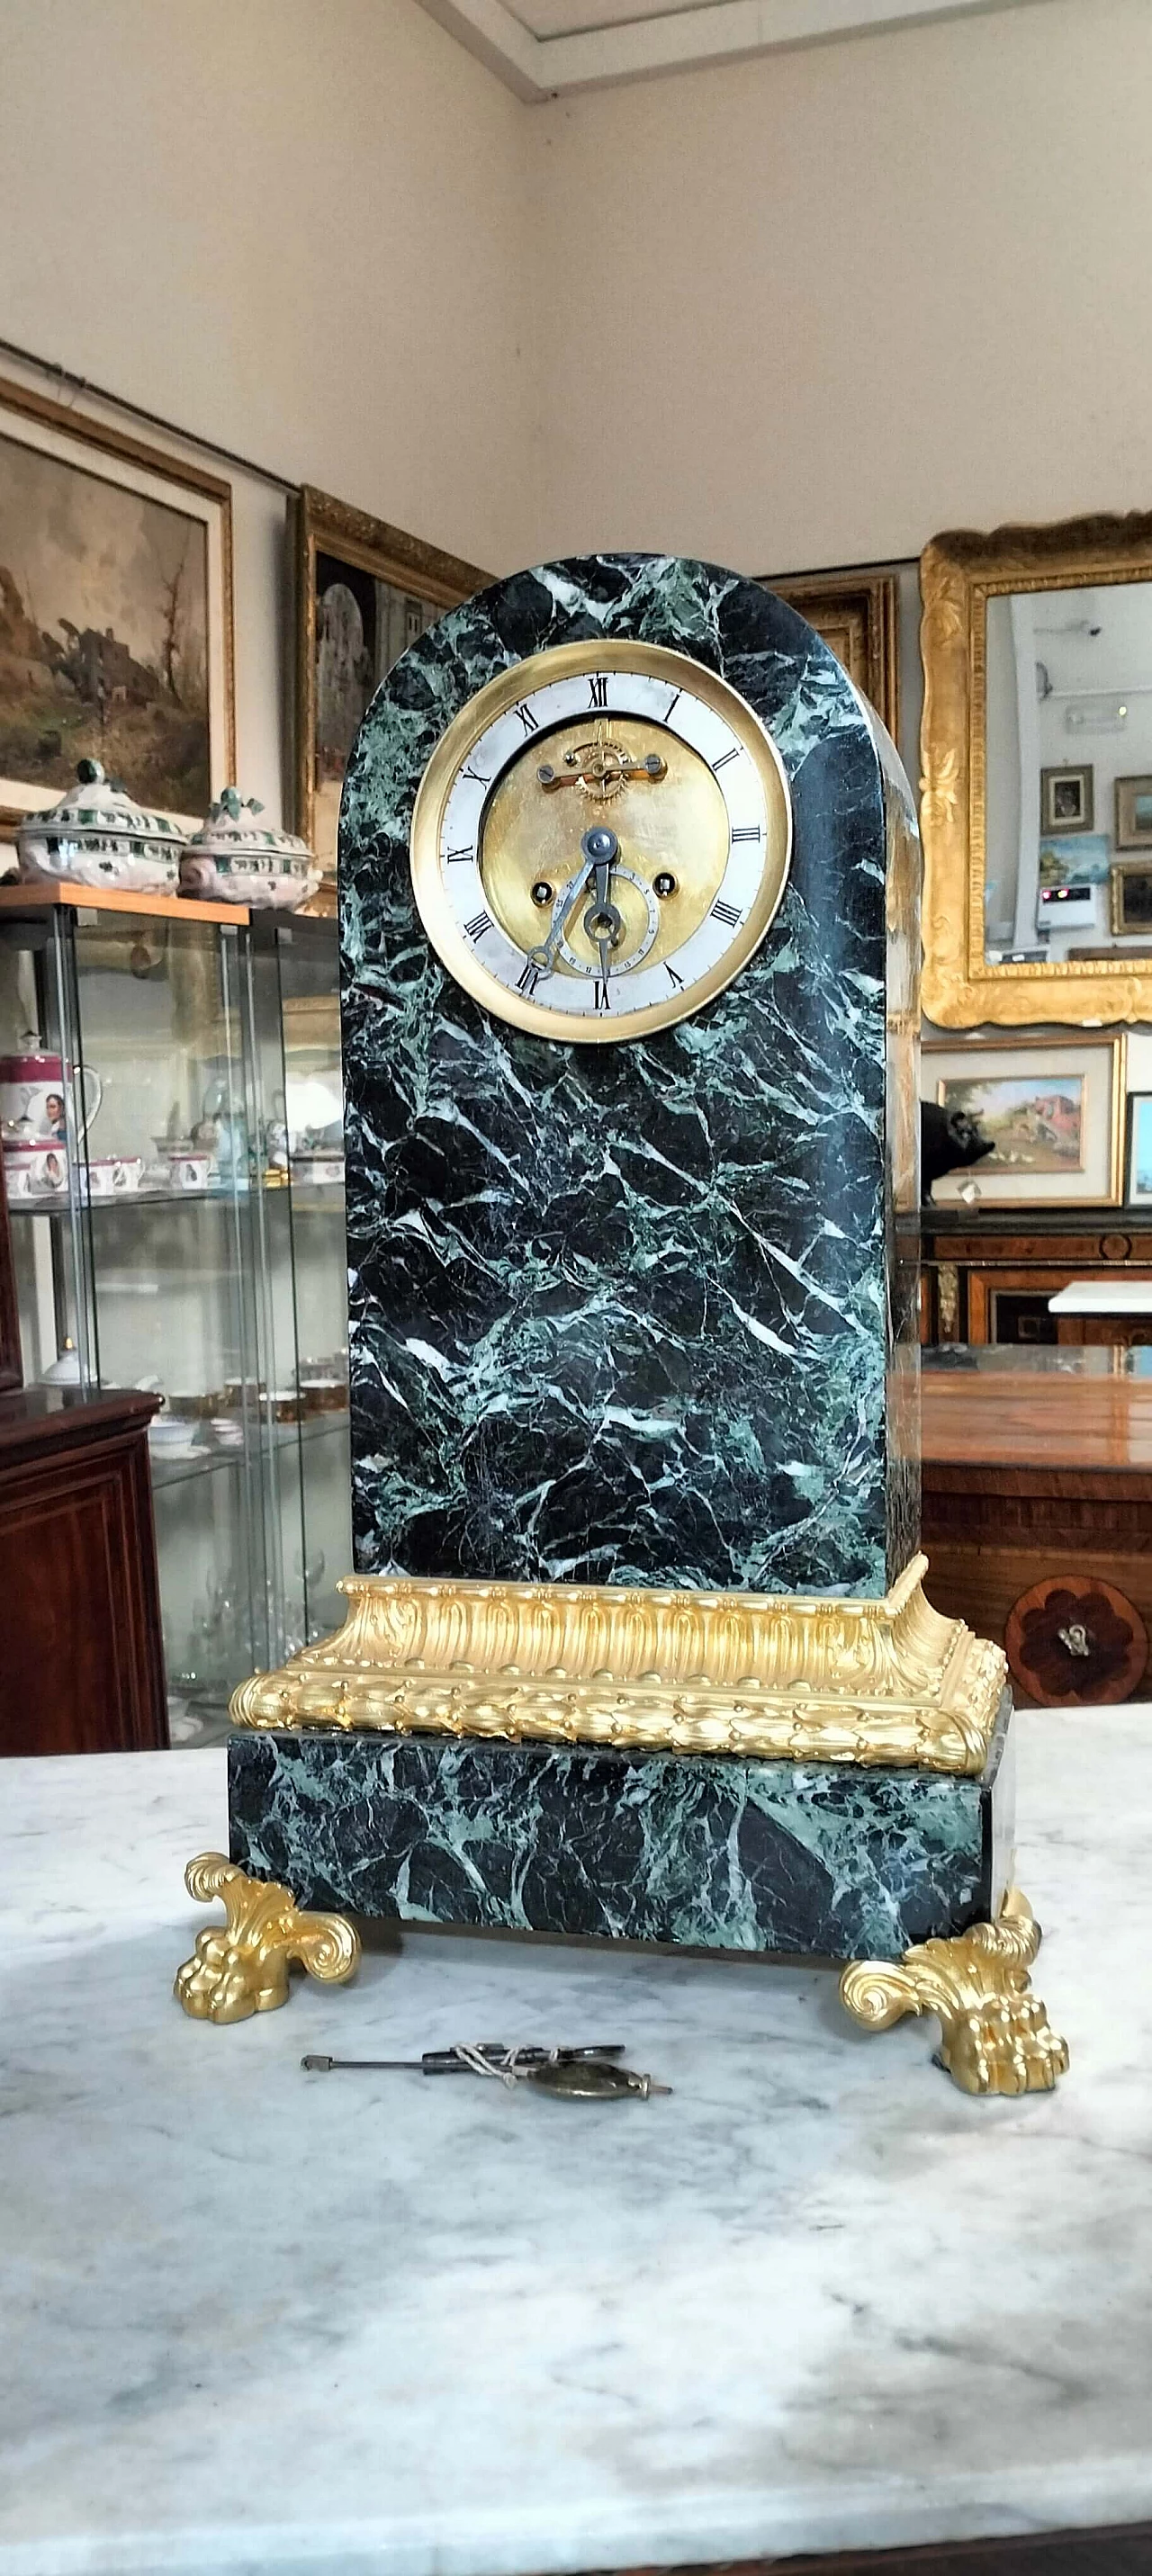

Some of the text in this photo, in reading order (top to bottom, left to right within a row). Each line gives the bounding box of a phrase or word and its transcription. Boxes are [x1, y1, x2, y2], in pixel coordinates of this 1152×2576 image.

[588, 677, 608, 709] XII
[514, 704, 539, 738] XI
[662, 694, 680, 723] I
[712, 748, 740, 773] II
[463, 766, 491, 791] X
[732, 824, 760, 844] III
[446, 845, 473, 864] IX
[464, 910, 494, 944] VIII
[710, 899, 742, 928] IIII
[663, 961, 685, 989] V
[593, 980, 611, 1010] VI
